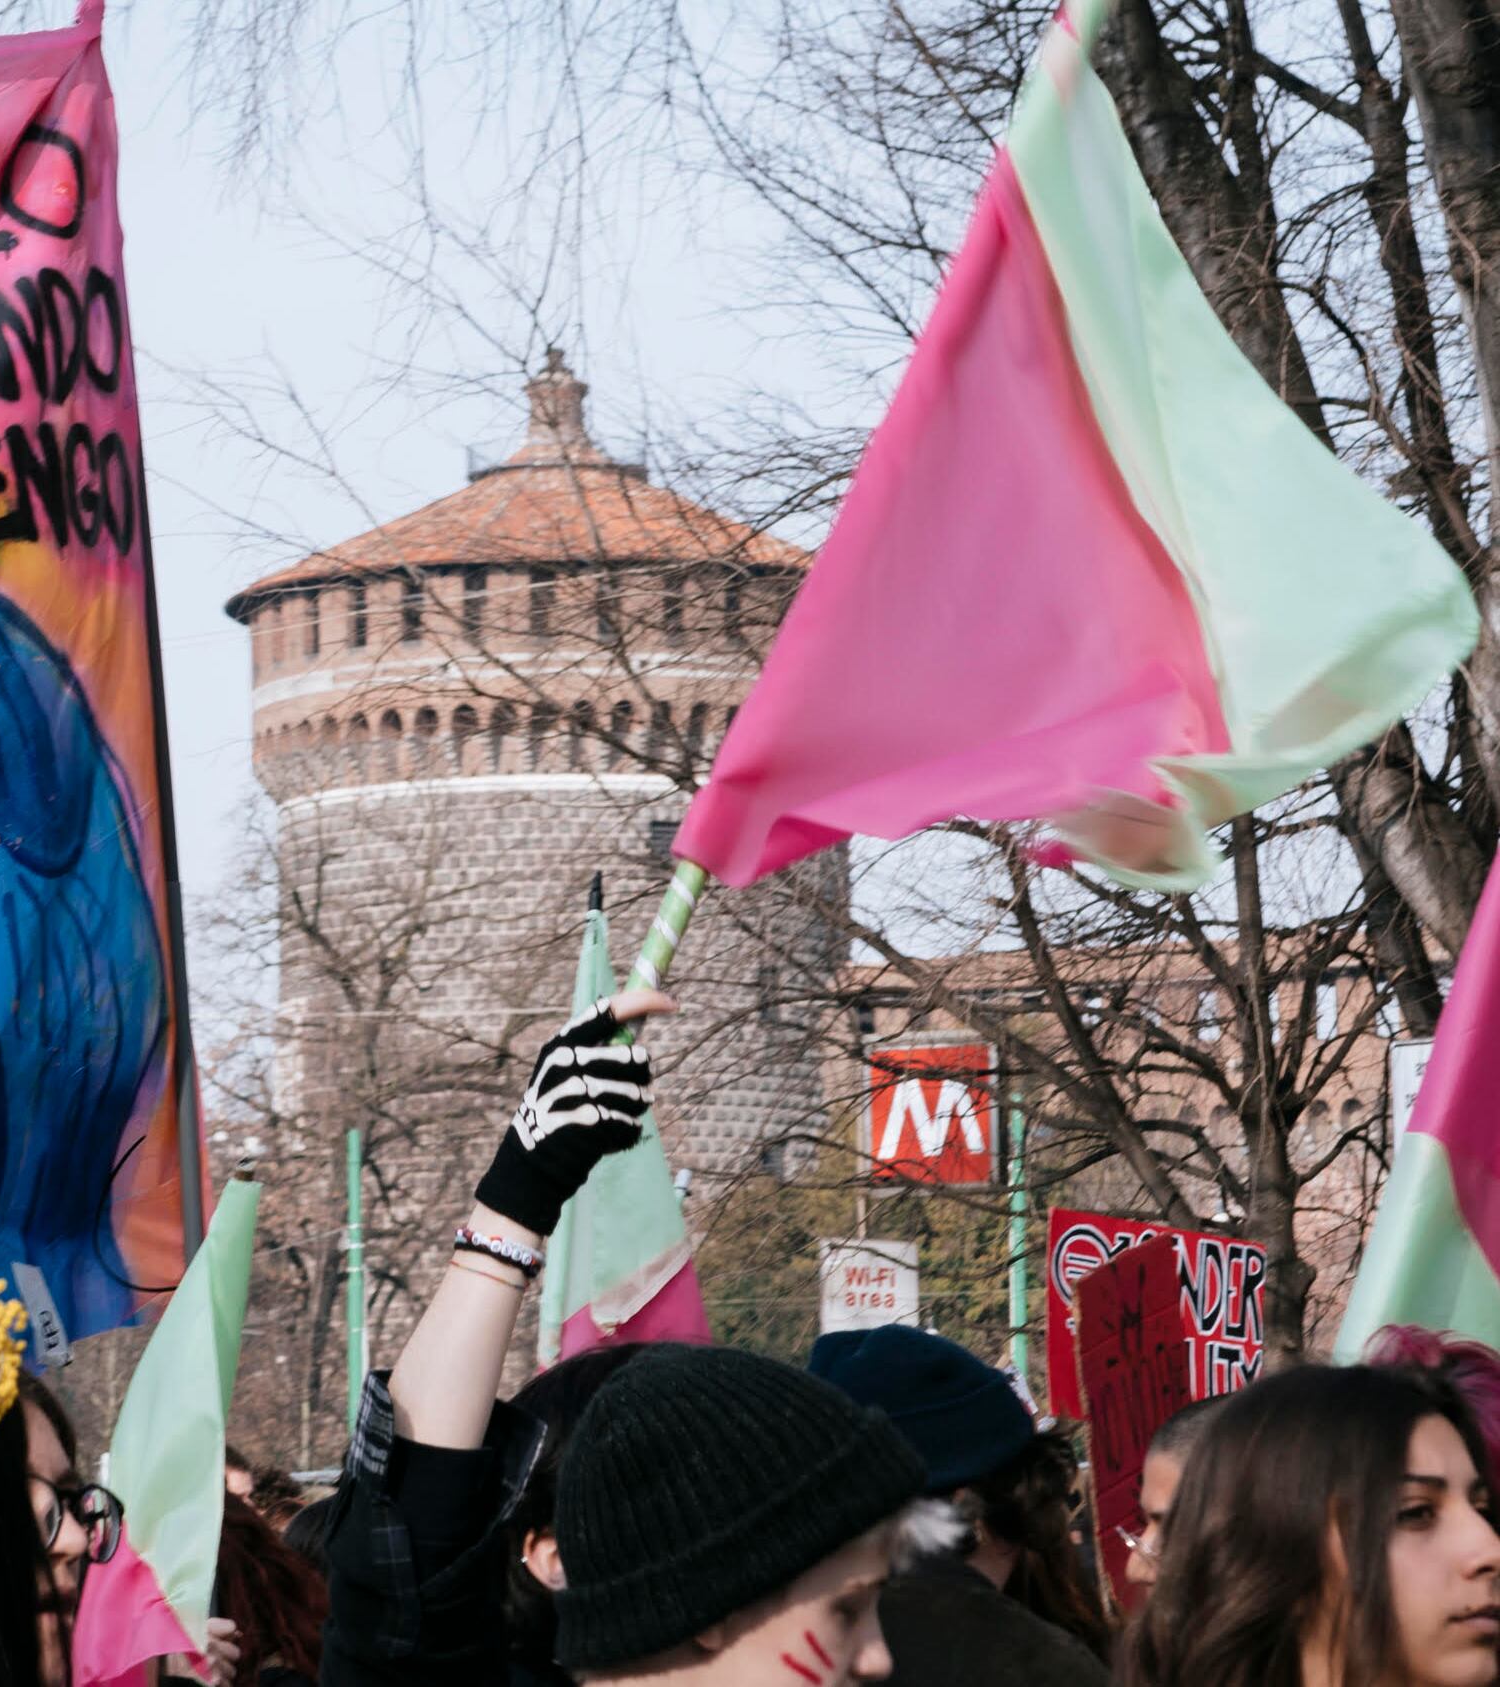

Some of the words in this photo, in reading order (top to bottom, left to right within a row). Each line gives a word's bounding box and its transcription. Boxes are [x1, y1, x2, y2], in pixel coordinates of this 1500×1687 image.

[876, 1074, 986, 1160] M
[845, 1266, 896, 1287] Wi-Fi
[845, 1292, 895, 1308] area
